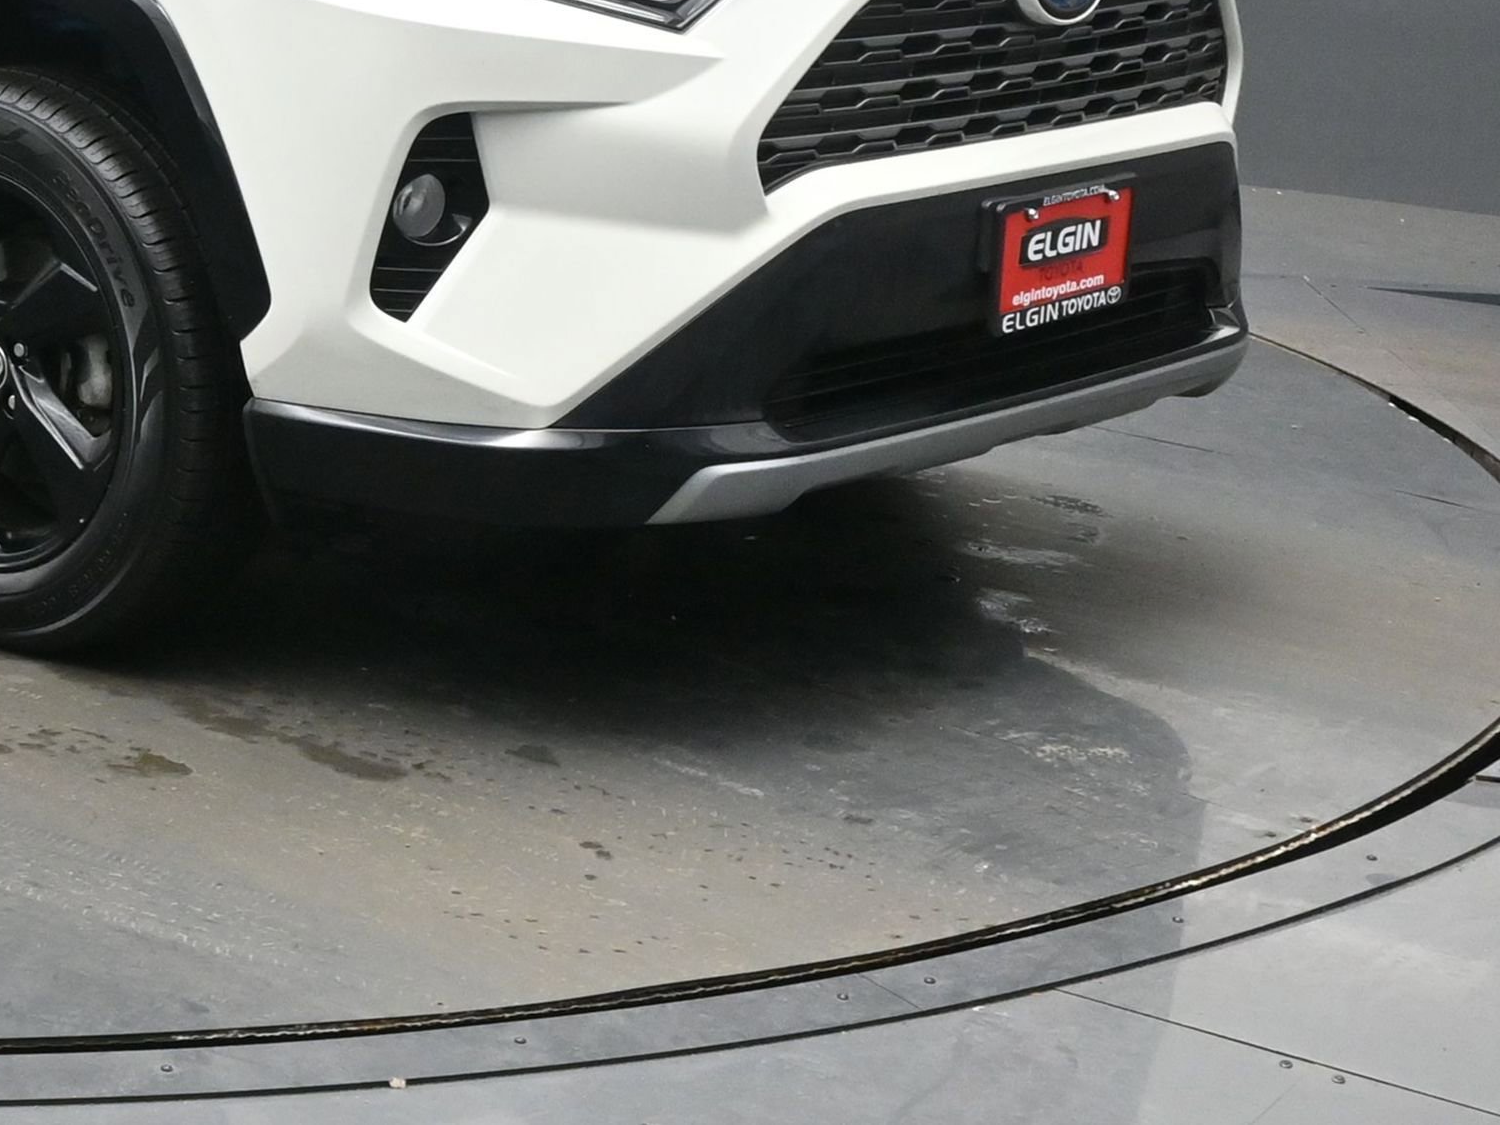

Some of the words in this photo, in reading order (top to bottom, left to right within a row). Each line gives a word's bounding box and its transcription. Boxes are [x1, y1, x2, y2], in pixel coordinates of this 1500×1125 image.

[1027, 220, 1101, 261] ELGIN
[1012, 274, 1104, 306] elgintoyota.com
[1002, 302, 1059, 333] ELGIN
[1061, 290, 1107, 316] TOYOTA
